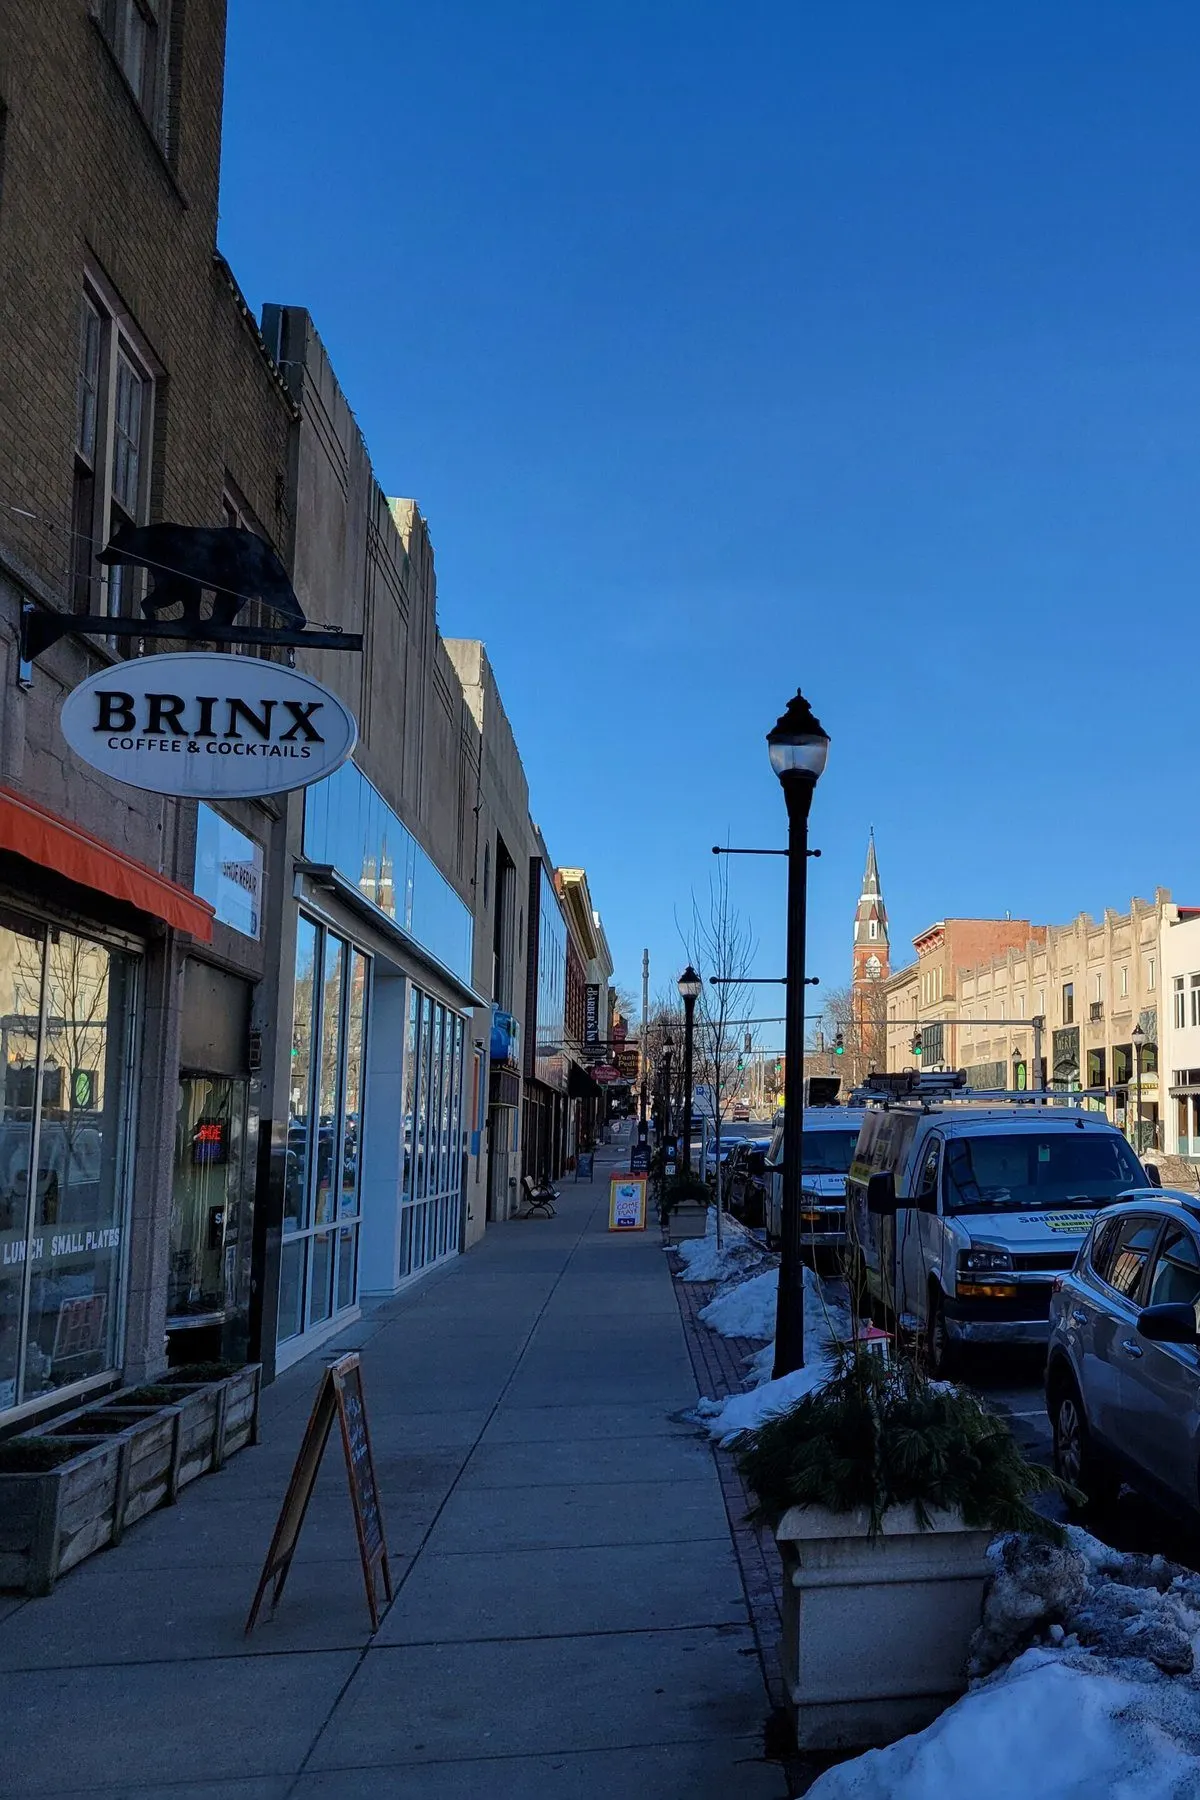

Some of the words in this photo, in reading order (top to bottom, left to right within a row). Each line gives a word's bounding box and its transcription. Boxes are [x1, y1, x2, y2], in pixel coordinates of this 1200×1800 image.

[92, 690, 325, 743] BRINX
[108, 737, 181, 753] COFFEE
[186, 741, 201, 754] &
[205, 741, 311, 759] COCKTAILS
[51, 1232, 84, 1257] SMALL
[85, 1227, 120, 1251] PLATES
